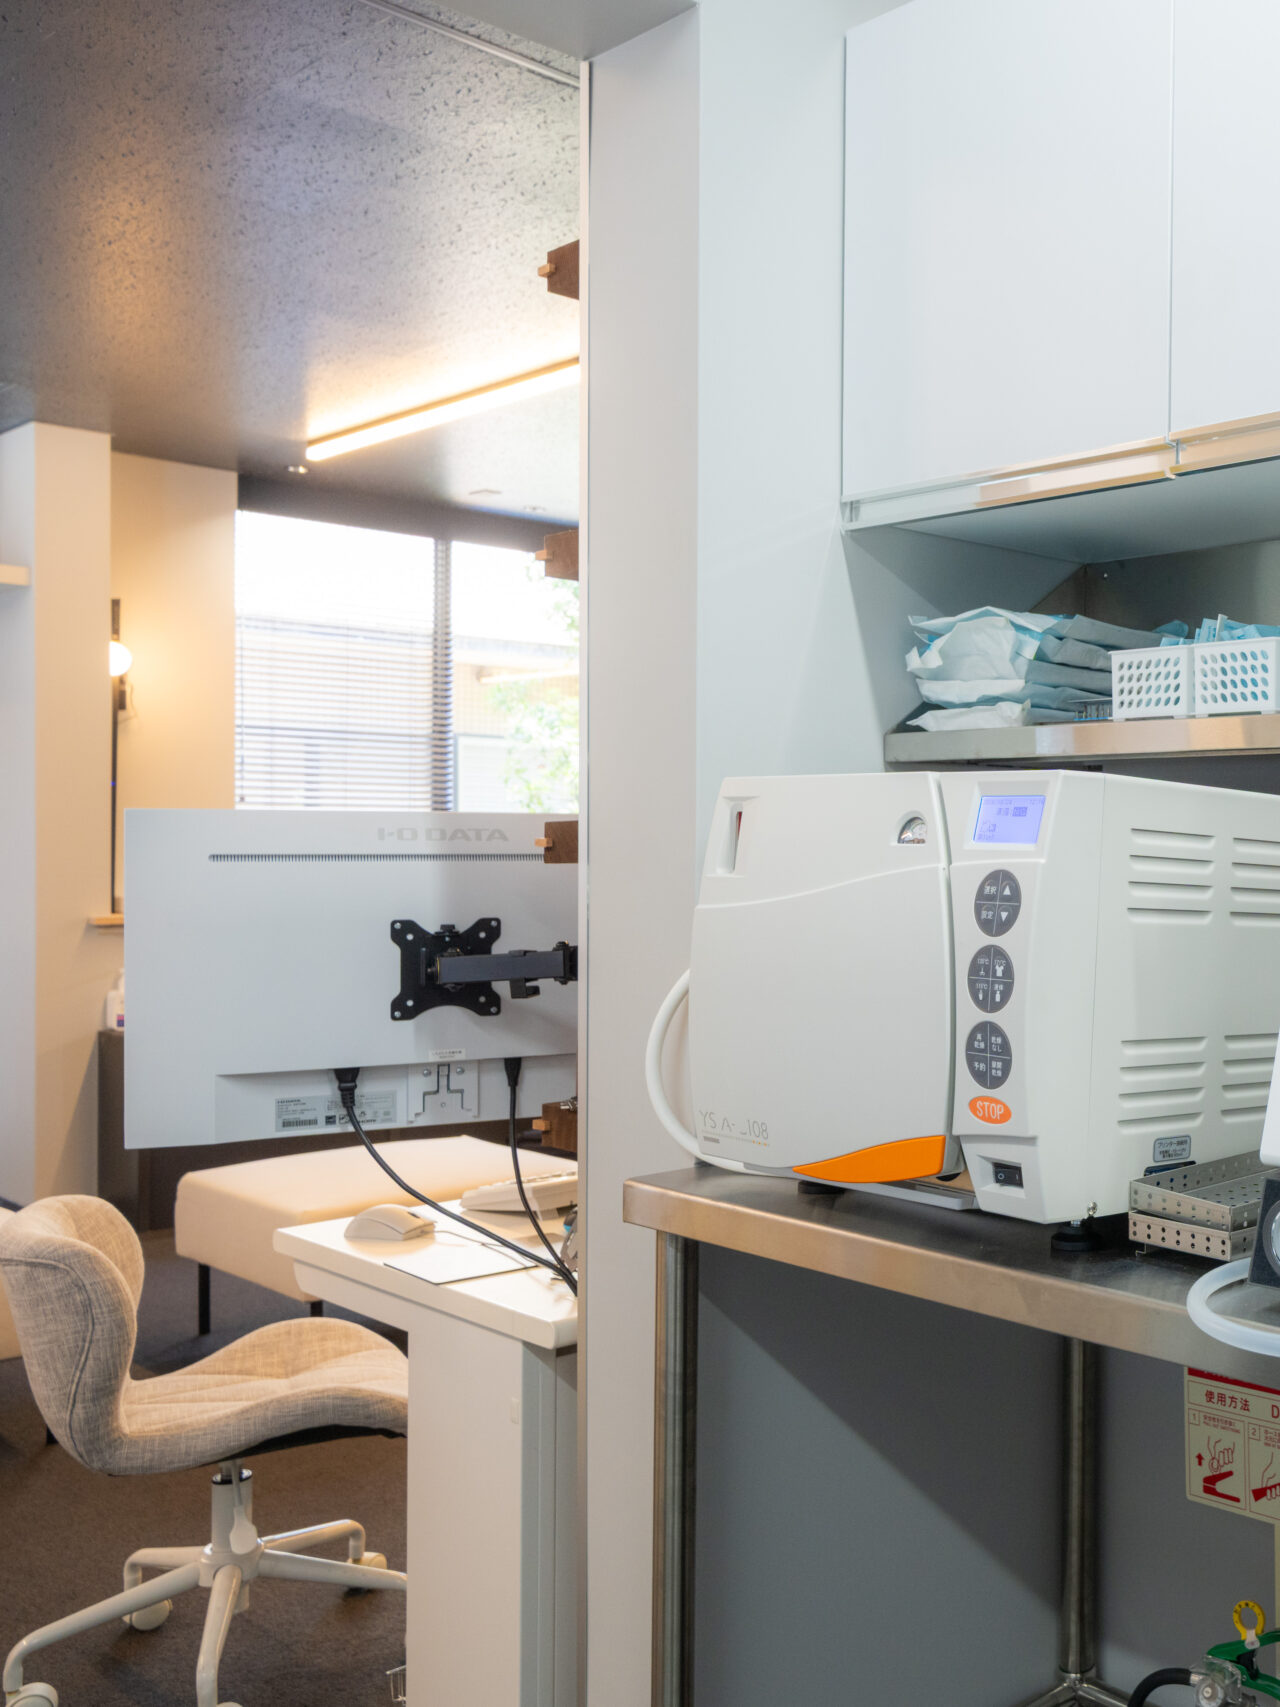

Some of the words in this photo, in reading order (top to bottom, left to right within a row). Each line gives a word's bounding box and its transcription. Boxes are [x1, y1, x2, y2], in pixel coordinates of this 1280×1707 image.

[976, 1100, 1004, 1120] STOP
[1204, 1389, 1250, 1412] 使用方法
[1251, 1427, 1257, 1436] 2
